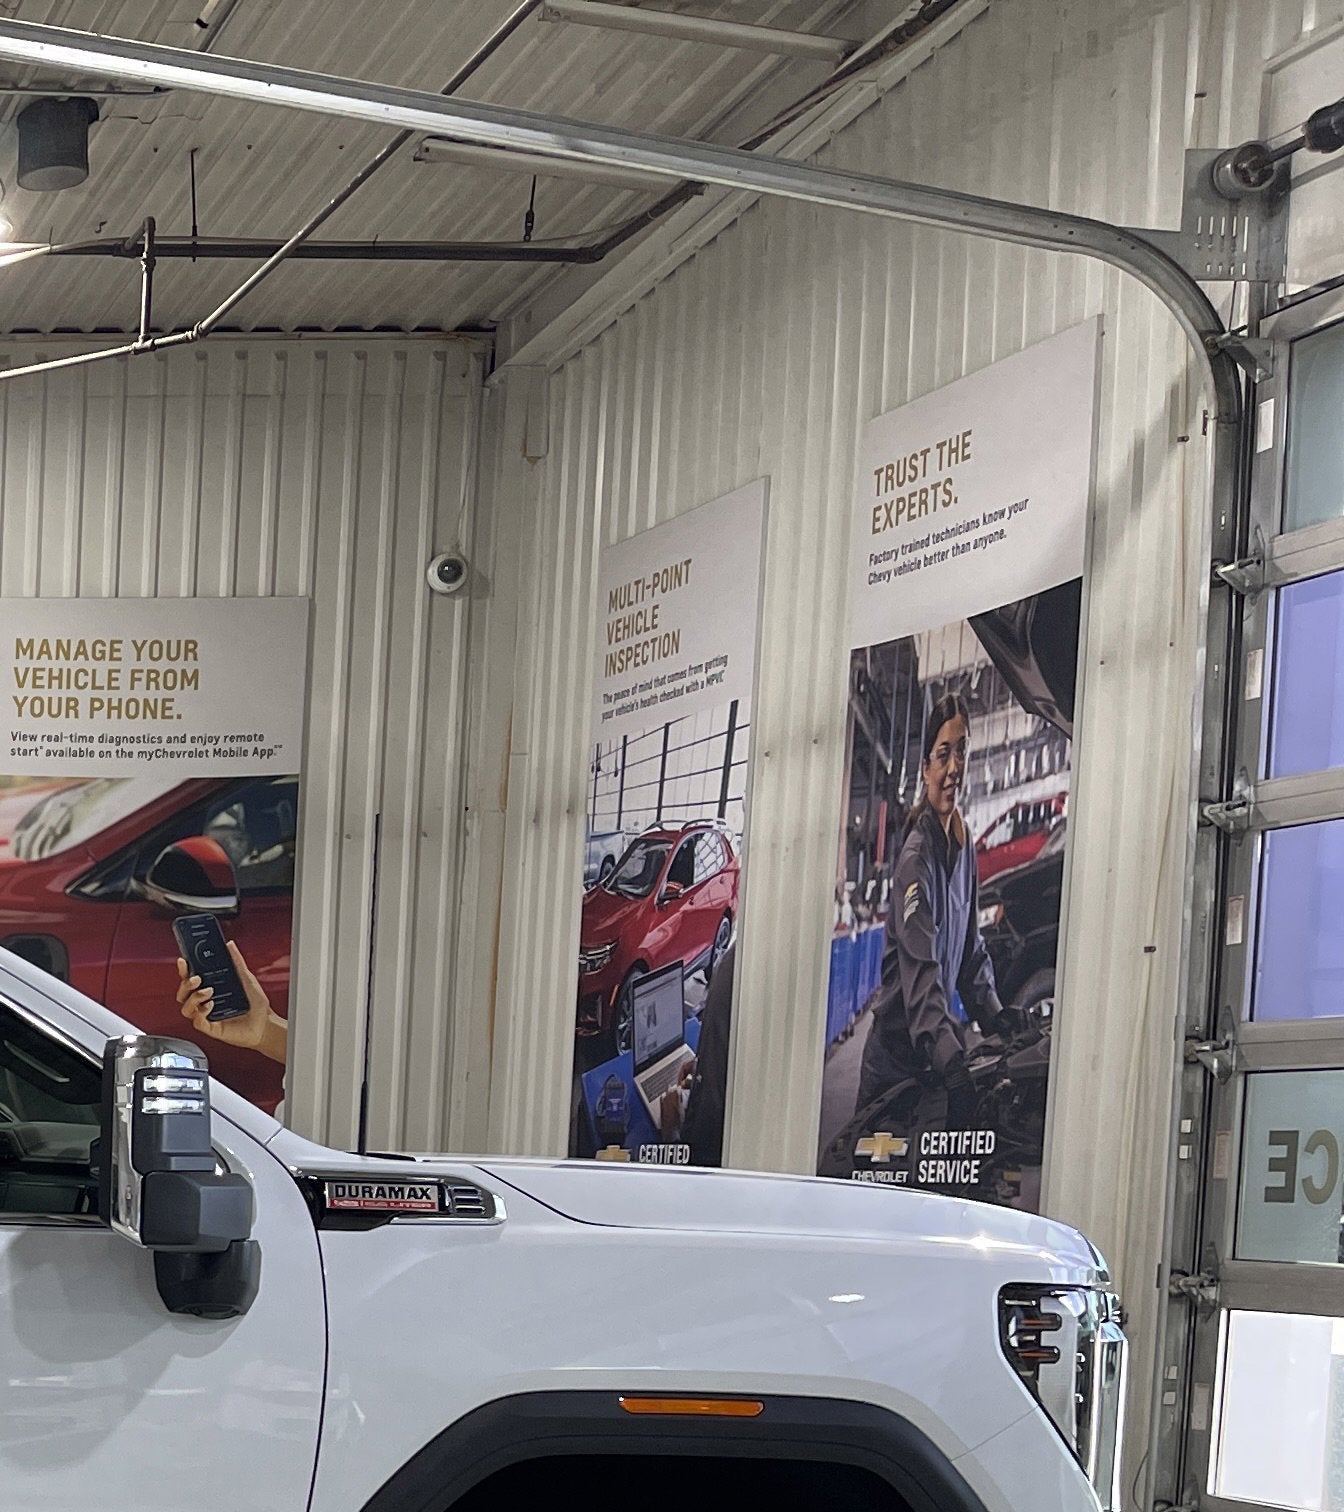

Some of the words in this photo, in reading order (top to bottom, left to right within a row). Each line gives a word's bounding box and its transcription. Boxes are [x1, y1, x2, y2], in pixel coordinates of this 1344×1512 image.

[874, 448, 930, 497] TRUST
[936, 429, 972, 472] THE
[872, 477, 959, 535] EXPERTS.
[869, 547, 899, 566] Factory
[901, 534, 930, 555] trained
[932, 518, 980, 544] technicians
[982, 508, 1006, 525] know
[1007, 499, 1029, 520] your
[868, 569, 892, 585] Chevy
[894, 556, 921, 577] vehicle
[924, 550, 950, 567] better
[952, 541, 971, 557] than
[973, 528, 1007, 549] anyone.
[608, 558, 692, 614] MULTI-POINT
[607, 604, 659, 645] VEHICLE
[15, 638, 123, 661] MANAGE
[131, 639, 199, 662] YOUR
[605, 629, 680, 678] INSPECTION
[14, 667, 120, 691] VEHICLE
[130, 668, 199, 691] FROM
[12, 695, 79, 719] YOUR
[89, 698, 182, 720] PHONE.
[11, 731, 38, 743] View
[41, 732, 94, 744] real-time
[98, 732, 163, 746] diagnostics
[165, 733, 186, 744] and
[190, 733, 220, 747] enjoy
[223, 732, 265, 744] remote
[45, 747, 95, 758] available
[98, 750, 112, 758] on
[115, 748, 134, 758] the
[137, 747, 210, 761] myChevrolet
[213, 747, 249, 758] Mobile
[639, 1144, 691, 1164] CERTIFIED
[920, 1131, 996, 1155] CERTIFIED
[852, 1170, 909, 1184] CHEVROLET
[918, 1160, 981, 1184] SERVICE
[335, 1184, 432, 1200] DURAMAX
